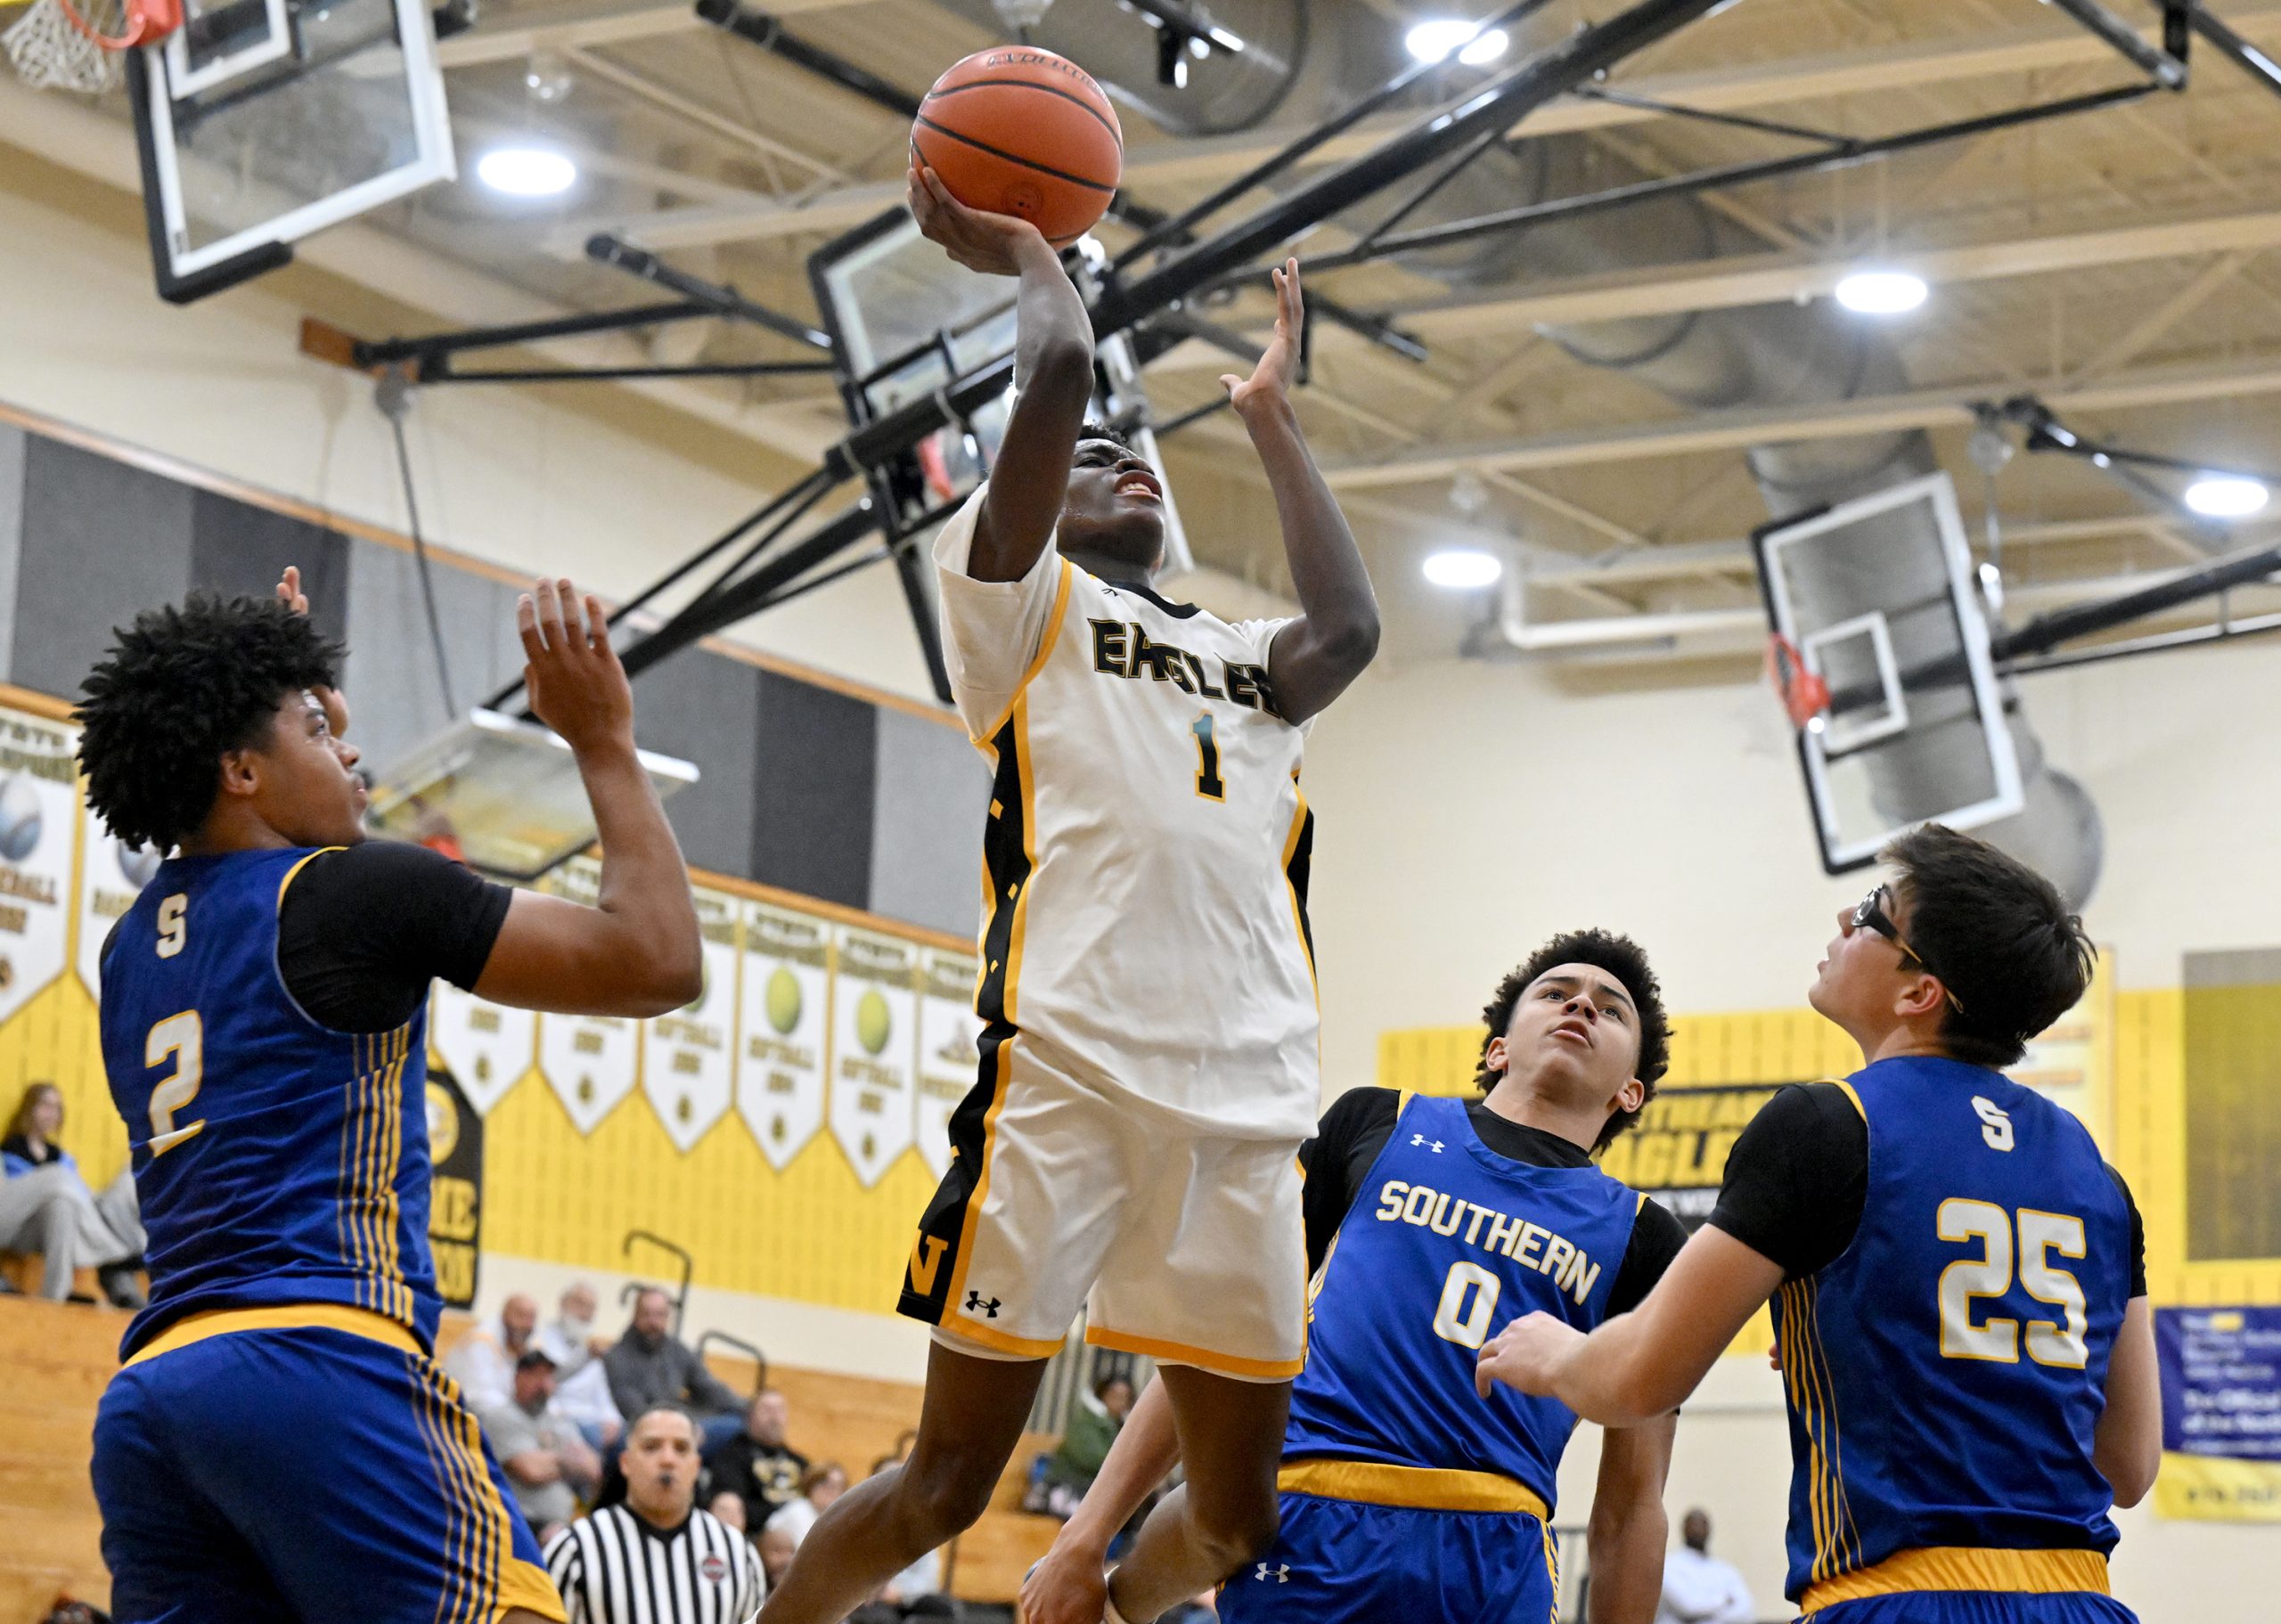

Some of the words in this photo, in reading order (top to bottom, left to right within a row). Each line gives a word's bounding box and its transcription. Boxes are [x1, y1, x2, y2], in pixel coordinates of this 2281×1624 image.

[1189, 708, 1227, 804] 1
[155, 892, 189, 959] S
[144, 1008, 208, 1158] 2
[1970, 1094, 2015, 1152] S
[1375, 1179, 1602, 1307] SOUTHERN
[1935, 1196, 2089, 1370] 25
[1432, 1260, 1502, 1351] 0
